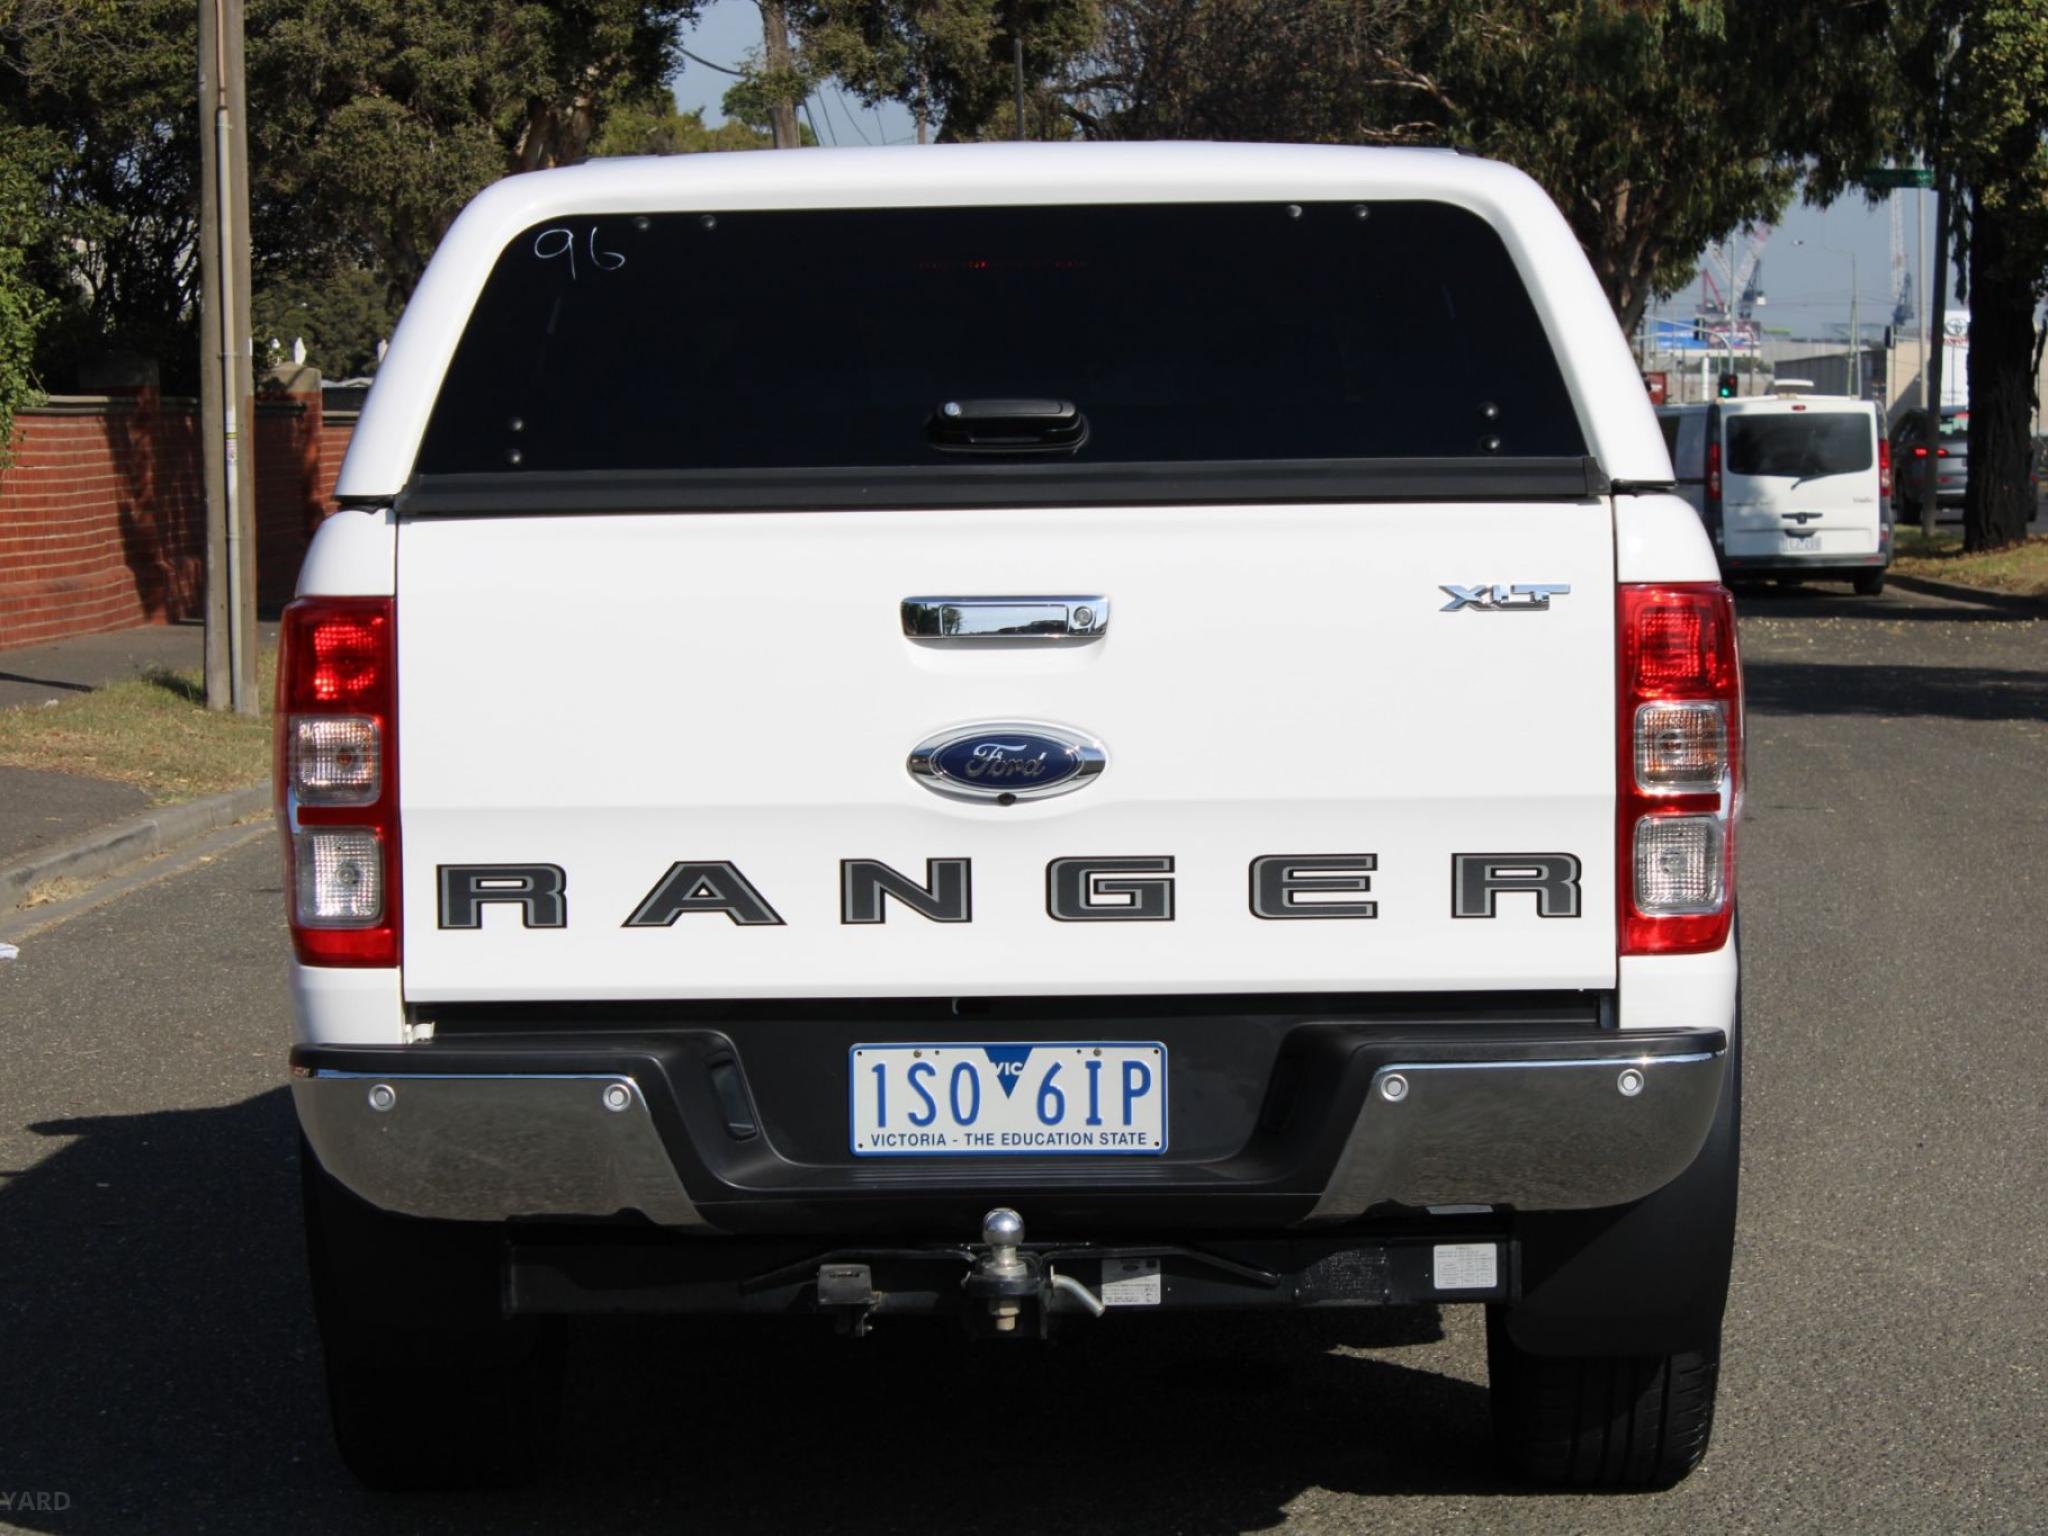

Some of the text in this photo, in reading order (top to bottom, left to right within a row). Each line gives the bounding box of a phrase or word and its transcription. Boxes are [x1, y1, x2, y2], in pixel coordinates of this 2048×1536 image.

[534, 226, 626, 280] 96
[1438, 584, 1571, 612] XLT
[965, 743, 1047, 778] Ford
[436, 852, 1582, 931] RANGER
[994, 1062, 1023, 1076] VIC
[871, 1134, 947, 1146] VICTORIA
[964, 1134, 994, 1146] THE
[1001, 1133, 1094, 1146] EDUCATION
[1099, 1132, 1148, 1145] STATE
